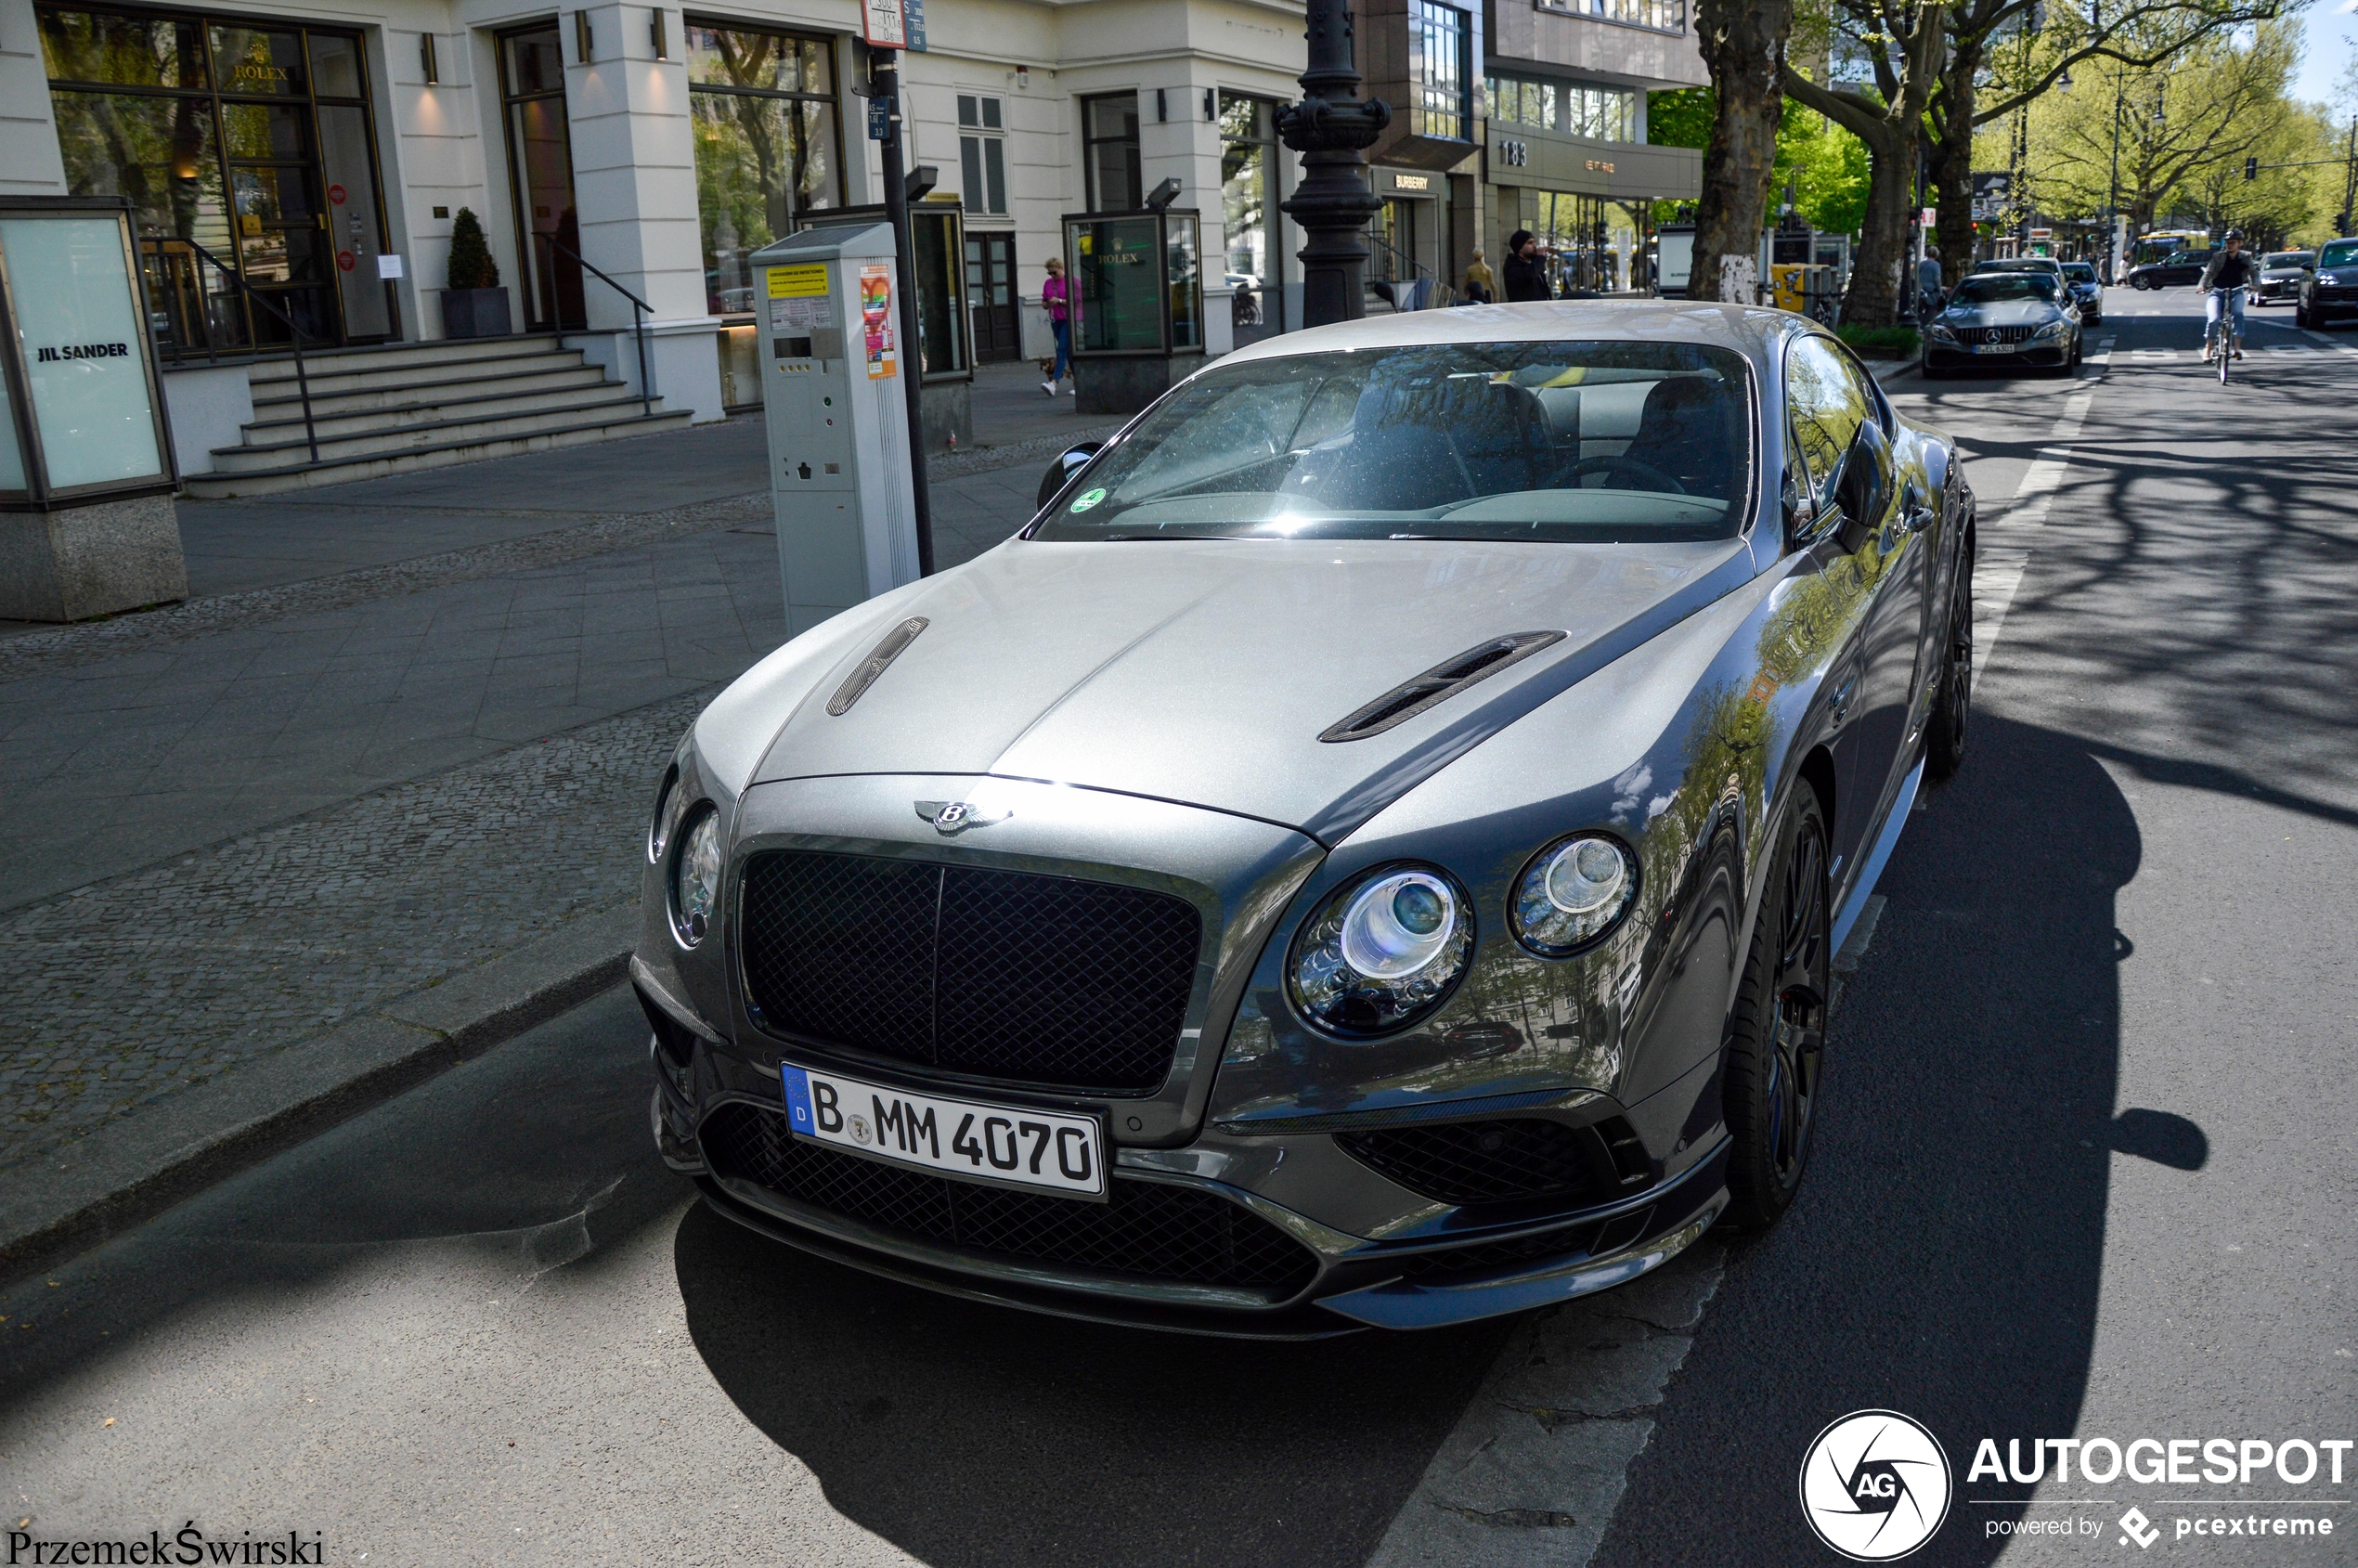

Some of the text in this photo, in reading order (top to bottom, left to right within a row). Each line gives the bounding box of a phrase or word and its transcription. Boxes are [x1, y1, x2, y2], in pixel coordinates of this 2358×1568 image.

[903, 1, 924, 16] S 300
[235, 65, 288, 80] ROLEX
[1502, 139, 1527, 167] 183
[1395, 174, 1429, 190] BURBERRY
[1098, 253, 1138, 264] ROLEX
[38, 343, 129, 362] JIL SANDER
[796, 1107, 806, 1121] D
[812, 1081, 844, 1133] B
[872, 1095, 940, 1159] MM
[952, 1113, 1092, 1181] 4070
